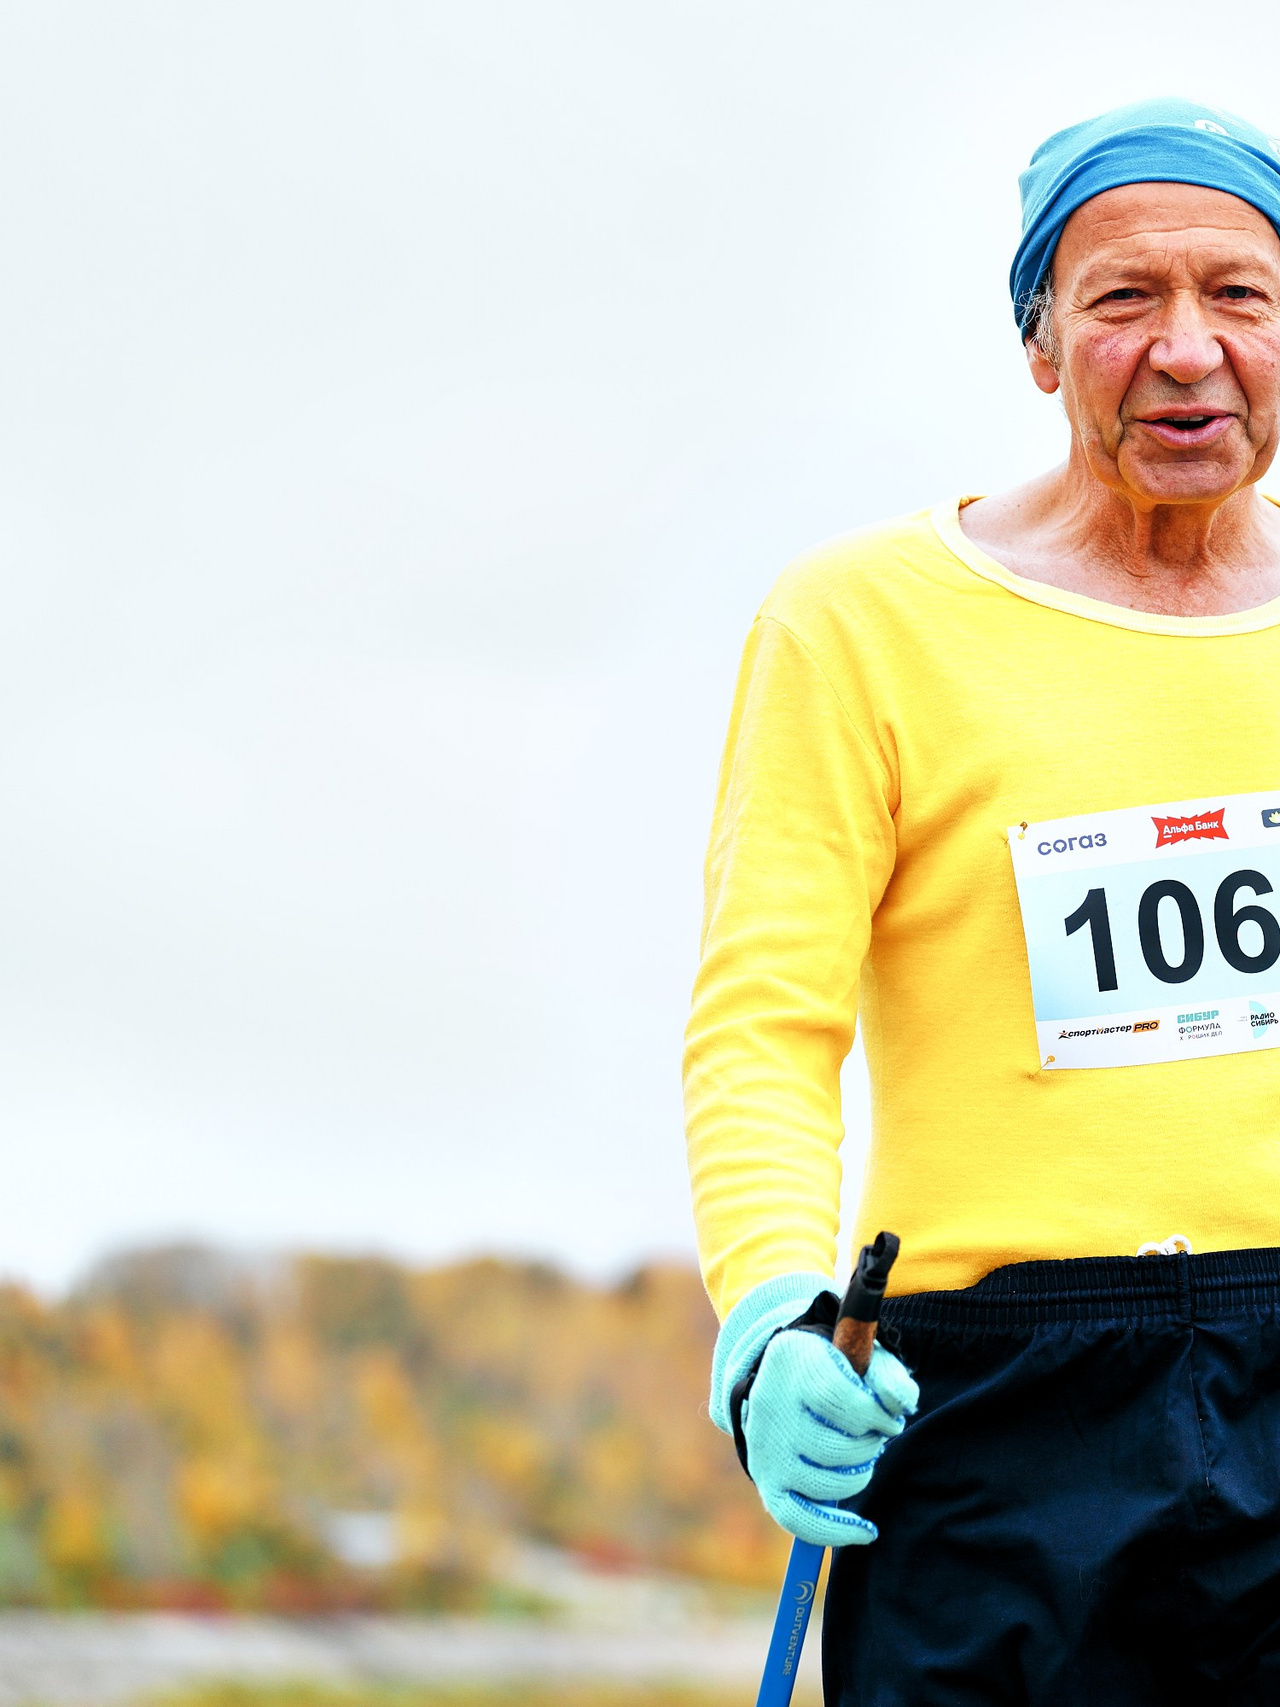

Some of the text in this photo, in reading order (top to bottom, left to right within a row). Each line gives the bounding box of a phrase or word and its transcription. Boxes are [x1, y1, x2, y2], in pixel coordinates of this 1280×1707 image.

[1163, 820, 1219, 838] Альфа Банк
[1177, 1010, 1219, 1024] СИБУР
[1250, 1011, 1275, 1021] РАДИО
[1133, 1021, 1159, 1032] PRO
[1178, 1022, 1221, 1034] ФОРМУЛА
[1250, 1018, 1279, 1028] СИБИРЬ
[783, 1607, 805, 1676] OUTVENTURE
